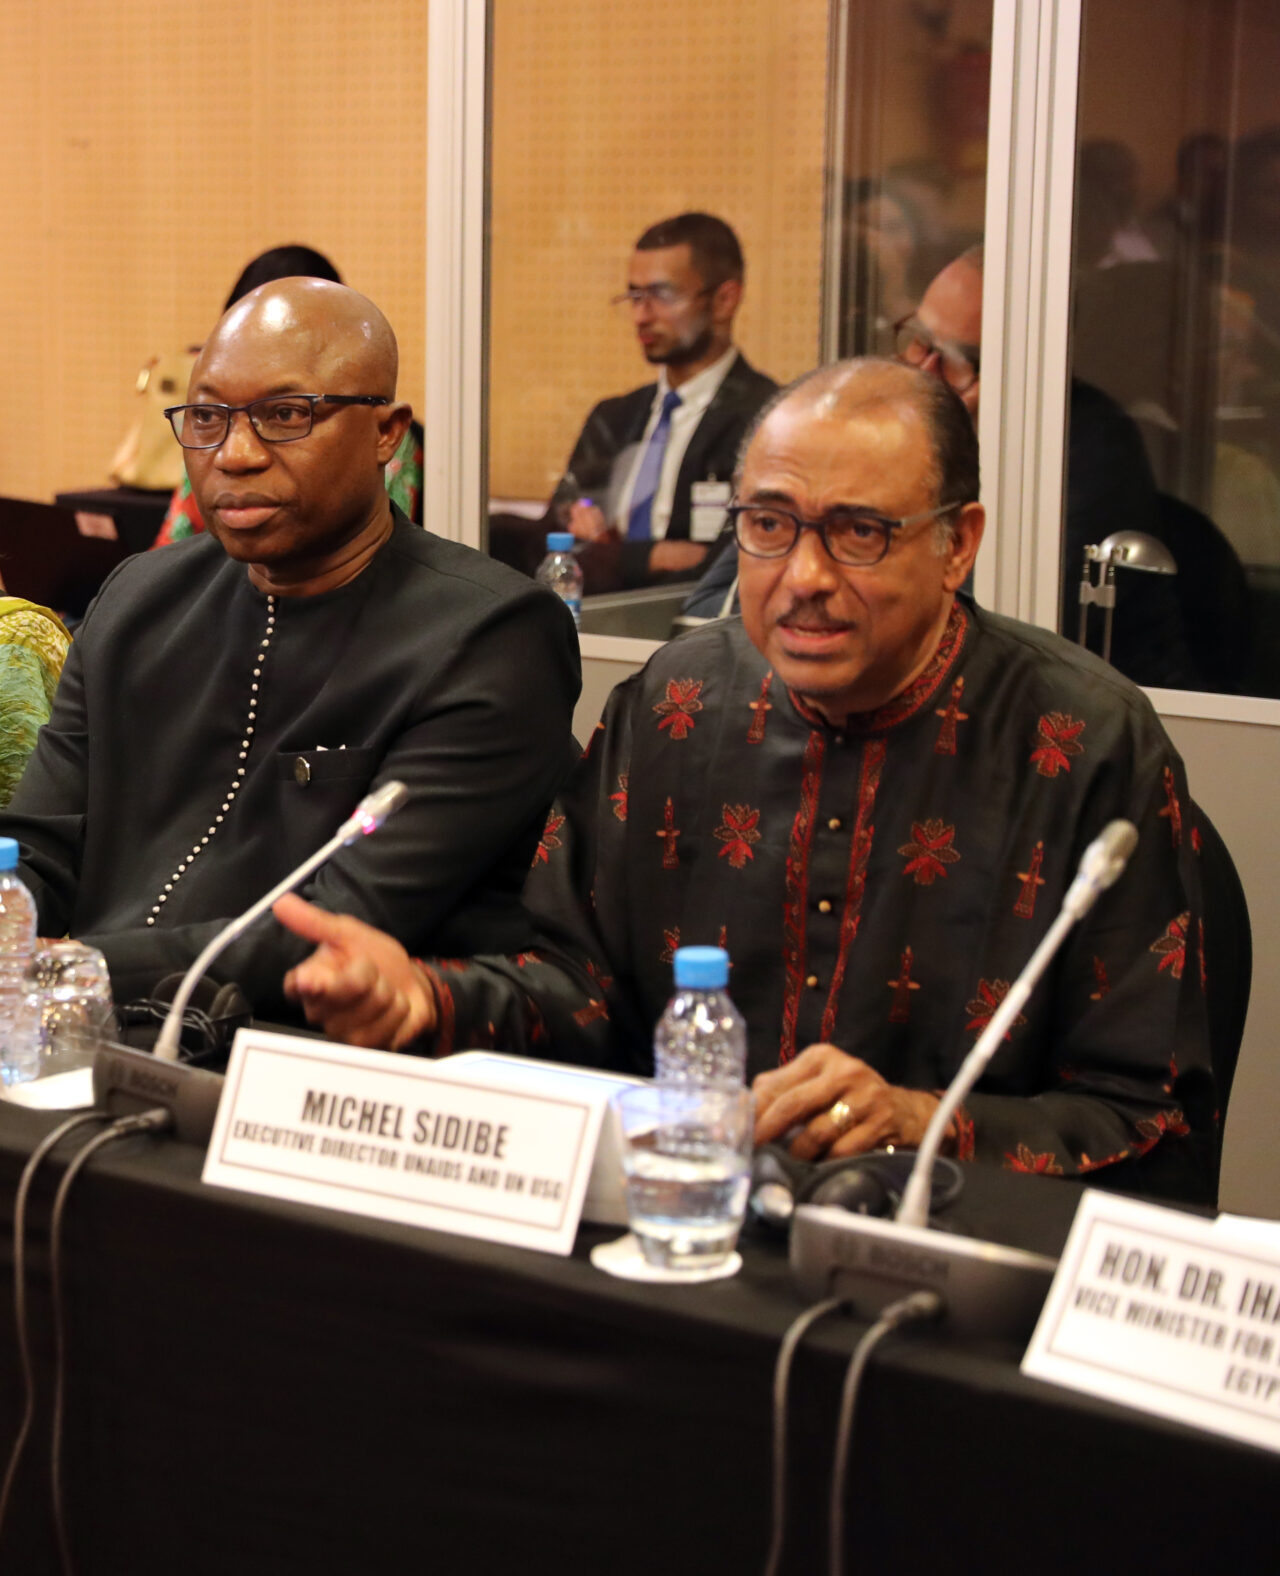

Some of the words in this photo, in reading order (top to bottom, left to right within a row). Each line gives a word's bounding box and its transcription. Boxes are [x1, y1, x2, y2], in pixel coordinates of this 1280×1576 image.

[233, 1119, 316, 1153] EXECUTIVE
[320, 1136, 399, 1169] DIRECTOR
[404, 1152, 463, 1181] UNAIDS
[469, 1164, 501, 1188] AND
[504, 1173, 525, 1193] UN
[301, 1089, 405, 1140] MICHEL
[412, 1109, 510, 1159] SIDIBE
[1097, 1241, 1169, 1295] HON.
[1177, 1261, 1228, 1311] DR.
[1074, 1285, 1120, 1319] VICE
[1124, 1299, 1229, 1349] MINISTER
[1231, 1327, 1276, 1361] FOR
[1223, 1362, 1280, 1401] EGYP
